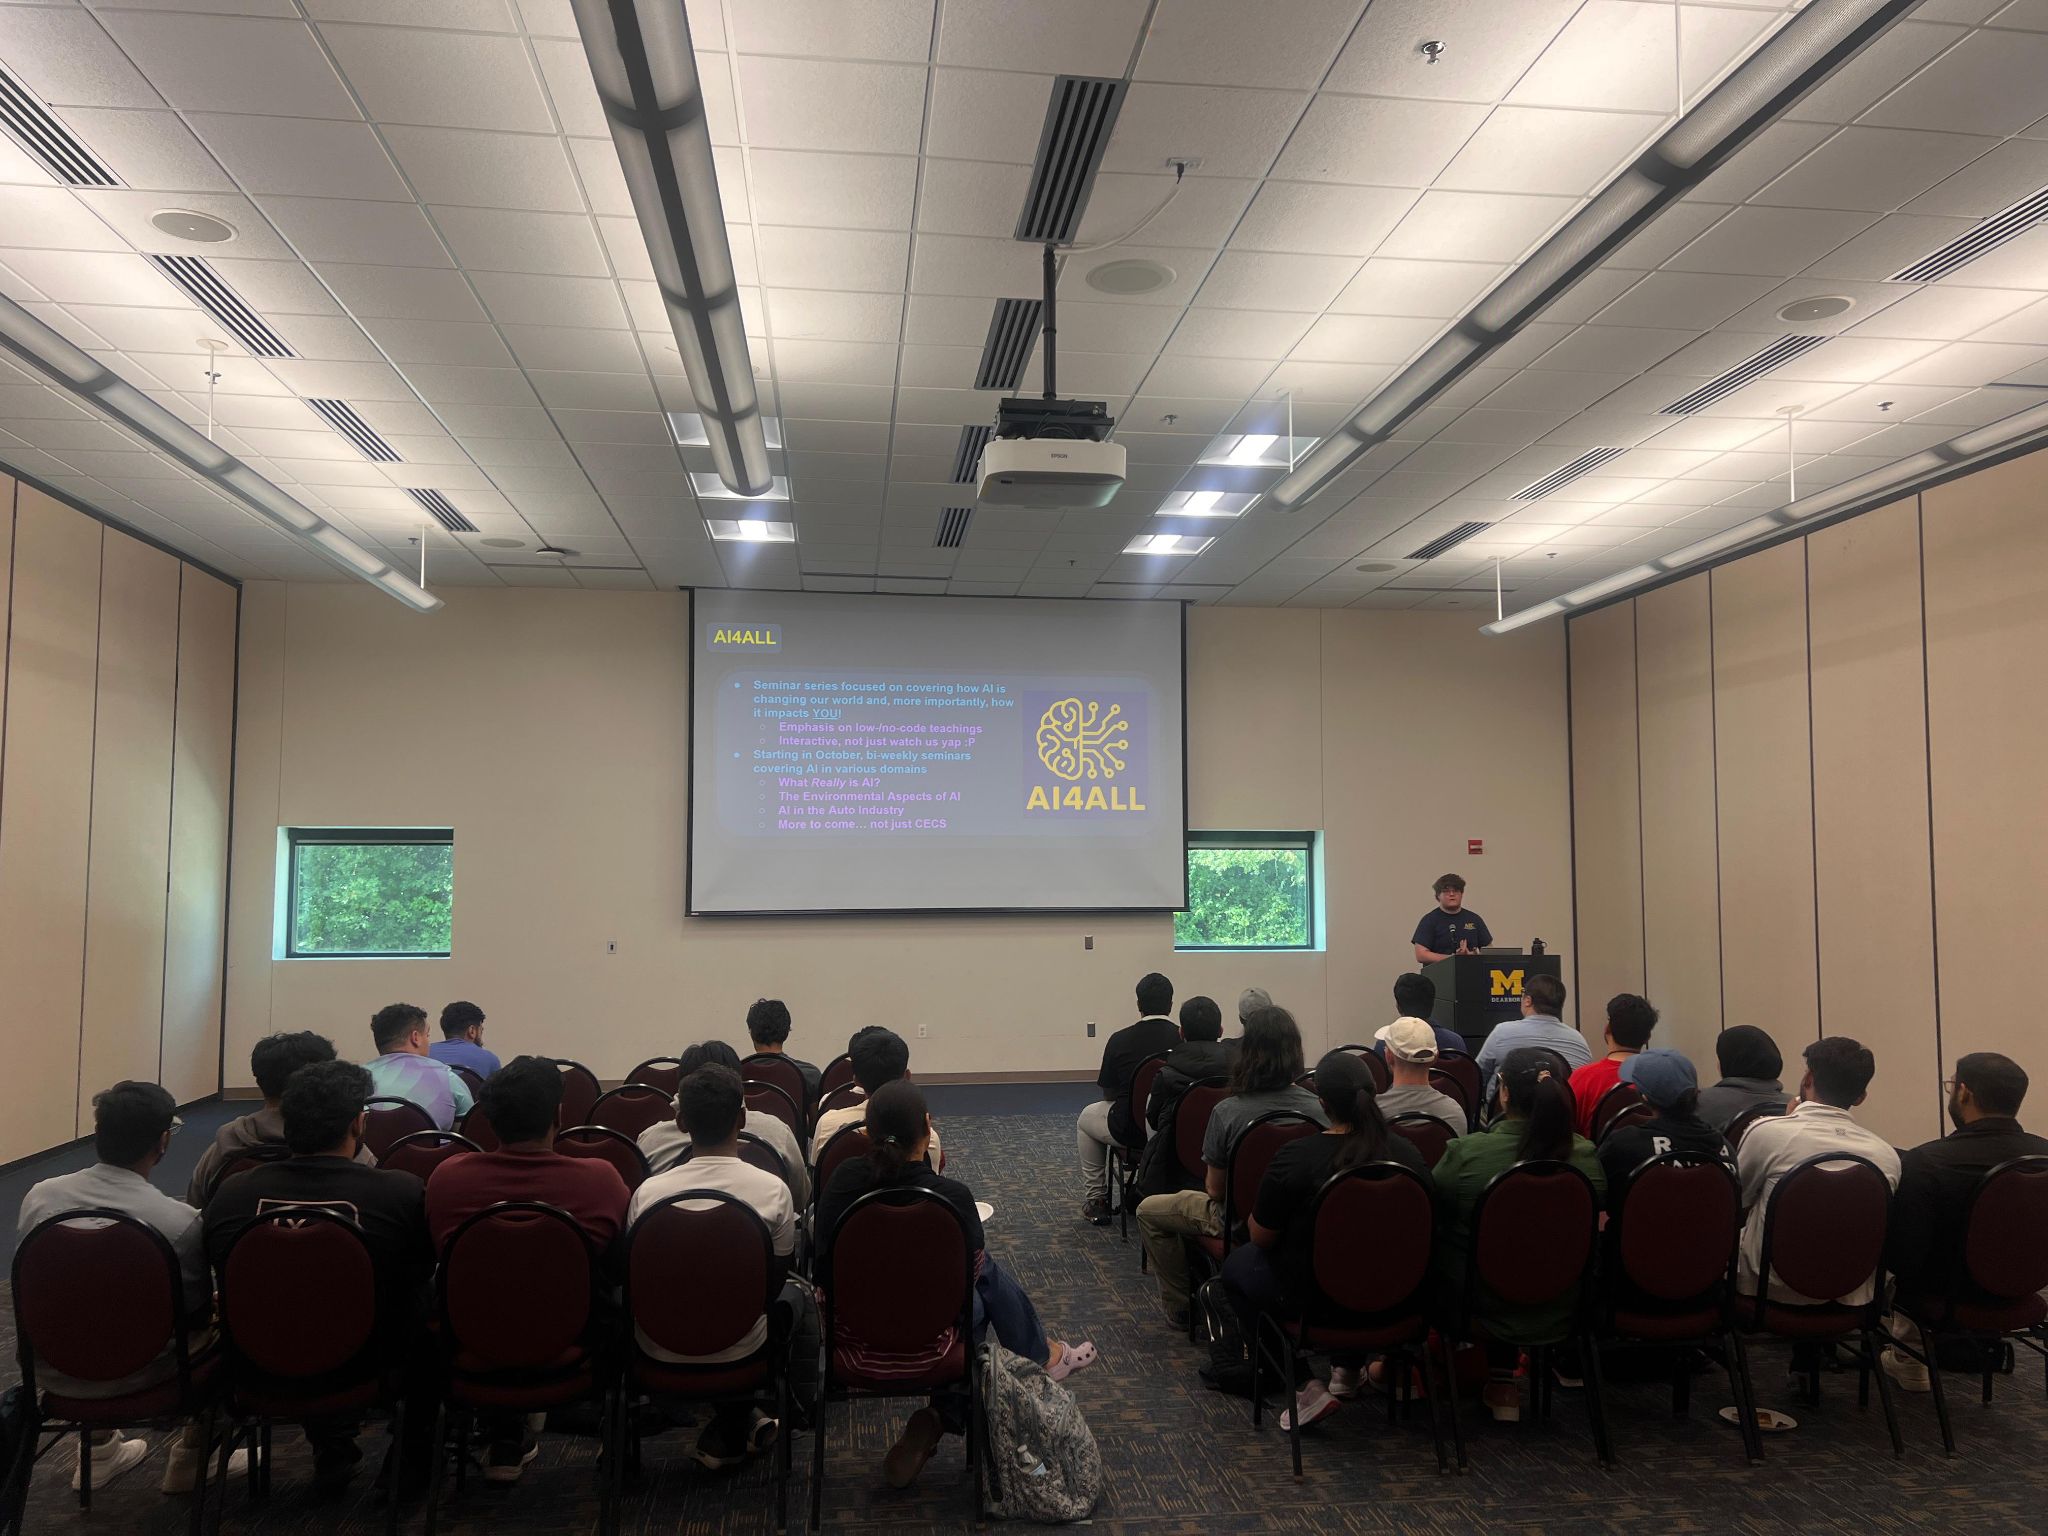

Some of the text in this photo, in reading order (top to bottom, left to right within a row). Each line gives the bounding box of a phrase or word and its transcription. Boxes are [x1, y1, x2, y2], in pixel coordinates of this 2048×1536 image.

[713, 629, 777, 645] AI4ALL
[753, 680, 801, 691] Seminar
[804, 681, 839, 691] series
[841, 682, 886, 692] focused
[906, 683, 954, 694] covering
[956, 683, 979, 693] how
[982, 684, 994, 693] AI
[996, 684, 1006, 694] is
[753, 694, 807, 706] changing
[810, 697, 829, 705] our
[832, 696, 864, 705] world
[866, 696, 891, 706] and,
[924, 697, 989, 708] importantly,
[991, 697, 1015, 707] how
[753, 708, 842, 720] it impacts YOU!
[779, 722, 834, 734] Emphasis
[855, 723, 927, 733] low-/no-code
[929, 724, 983, 736] teachings
[779, 736, 842, 747] Interactive,
[844, 737, 864, 746] not
[865, 737, 887, 748] just
[889, 737, 922, 747] watch
[941, 740, 961, 749] yap
[964, 737, 976, 747] :P
[753, 750, 799, 761] Starting
[802, 750, 812, 759] in
[866, 750, 919, 762] bi-weekly
[921, 751, 972, 760] seminars
[753, 764, 928, 775] covering AI in various domains
[778, 777, 881, 789] What Really is AI?
[779, 791, 961, 803] The Environmental Aspects of AI
[1026, 785, 1146, 811] AI4ALL
[778, 805, 905, 817] AI in the Auto Industry
[778, 819, 947, 831] More to come... not just CECS
[1490, 969, 1524, 996] M
